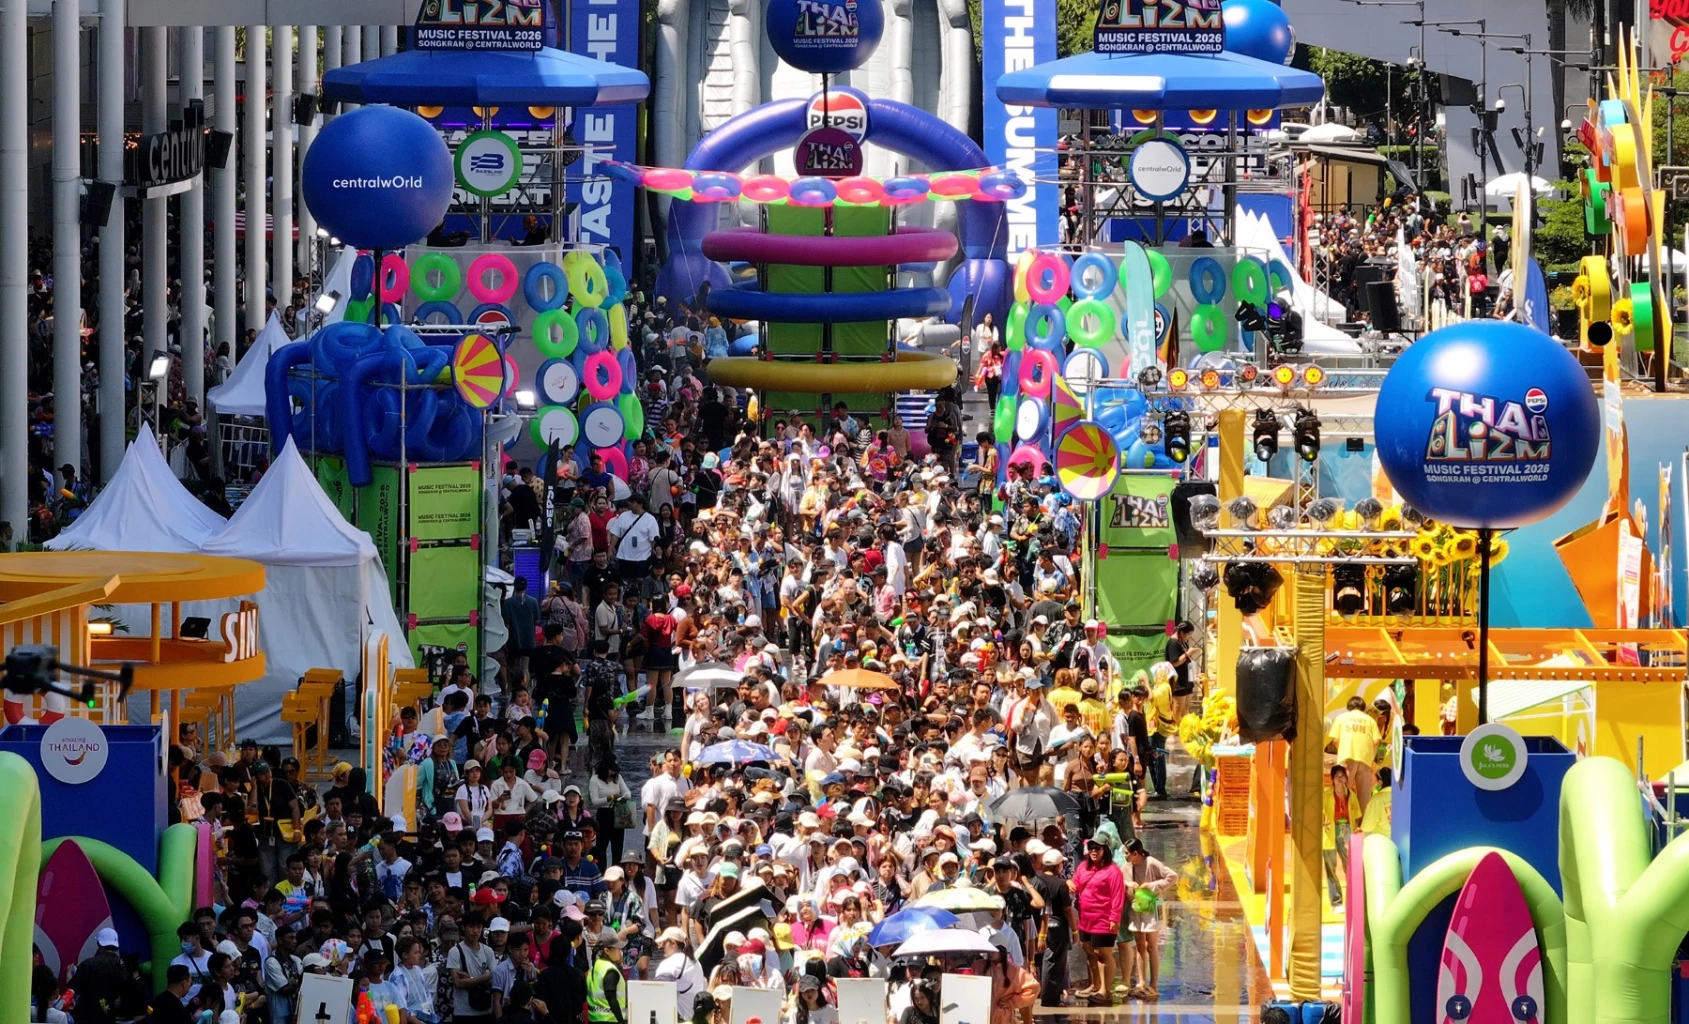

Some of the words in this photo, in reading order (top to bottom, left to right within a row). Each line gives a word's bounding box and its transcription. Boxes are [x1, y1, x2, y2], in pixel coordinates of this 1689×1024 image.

[418, 30, 456, 39] MUSIC
[458, 30, 512, 40] FESTIVAL
[514, 31, 542, 41] 2026
[1098, 33, 1136, 43] MUSIC
[1138, 33, 1193, 43] FESTIVAL
[1195, 33, 1222, 43] 2026
[418, 40, 465, 48] SONGKRAN
[465, 41, 474, 49] @
[475, 41, 542, 49] CENTRALWORLD
[1098, 43, 1145, 51] SONGKRAN
[1145, 44, 1154, 53] @
[1155, 43, 1222, 51] CENTRALWORLD
[810, 114, 864, 129] PEPSI
[332, 175, 423, 189] centralwOrld
[1423, 464, 1461, 475] MUSIC
[1463, 465, 1522, 475] FESTIVAL
[1524, 464, 1550, 474] 2026
[1426, 475, 1471, 483] SONGKRAN
[1472, 476, 1481, 484] @
[1482, 474, 1548, 483] CENTRALWORLD
[546, 485, 554, 528] PEPSI
[48, 743, 100, 752] THAILAND
